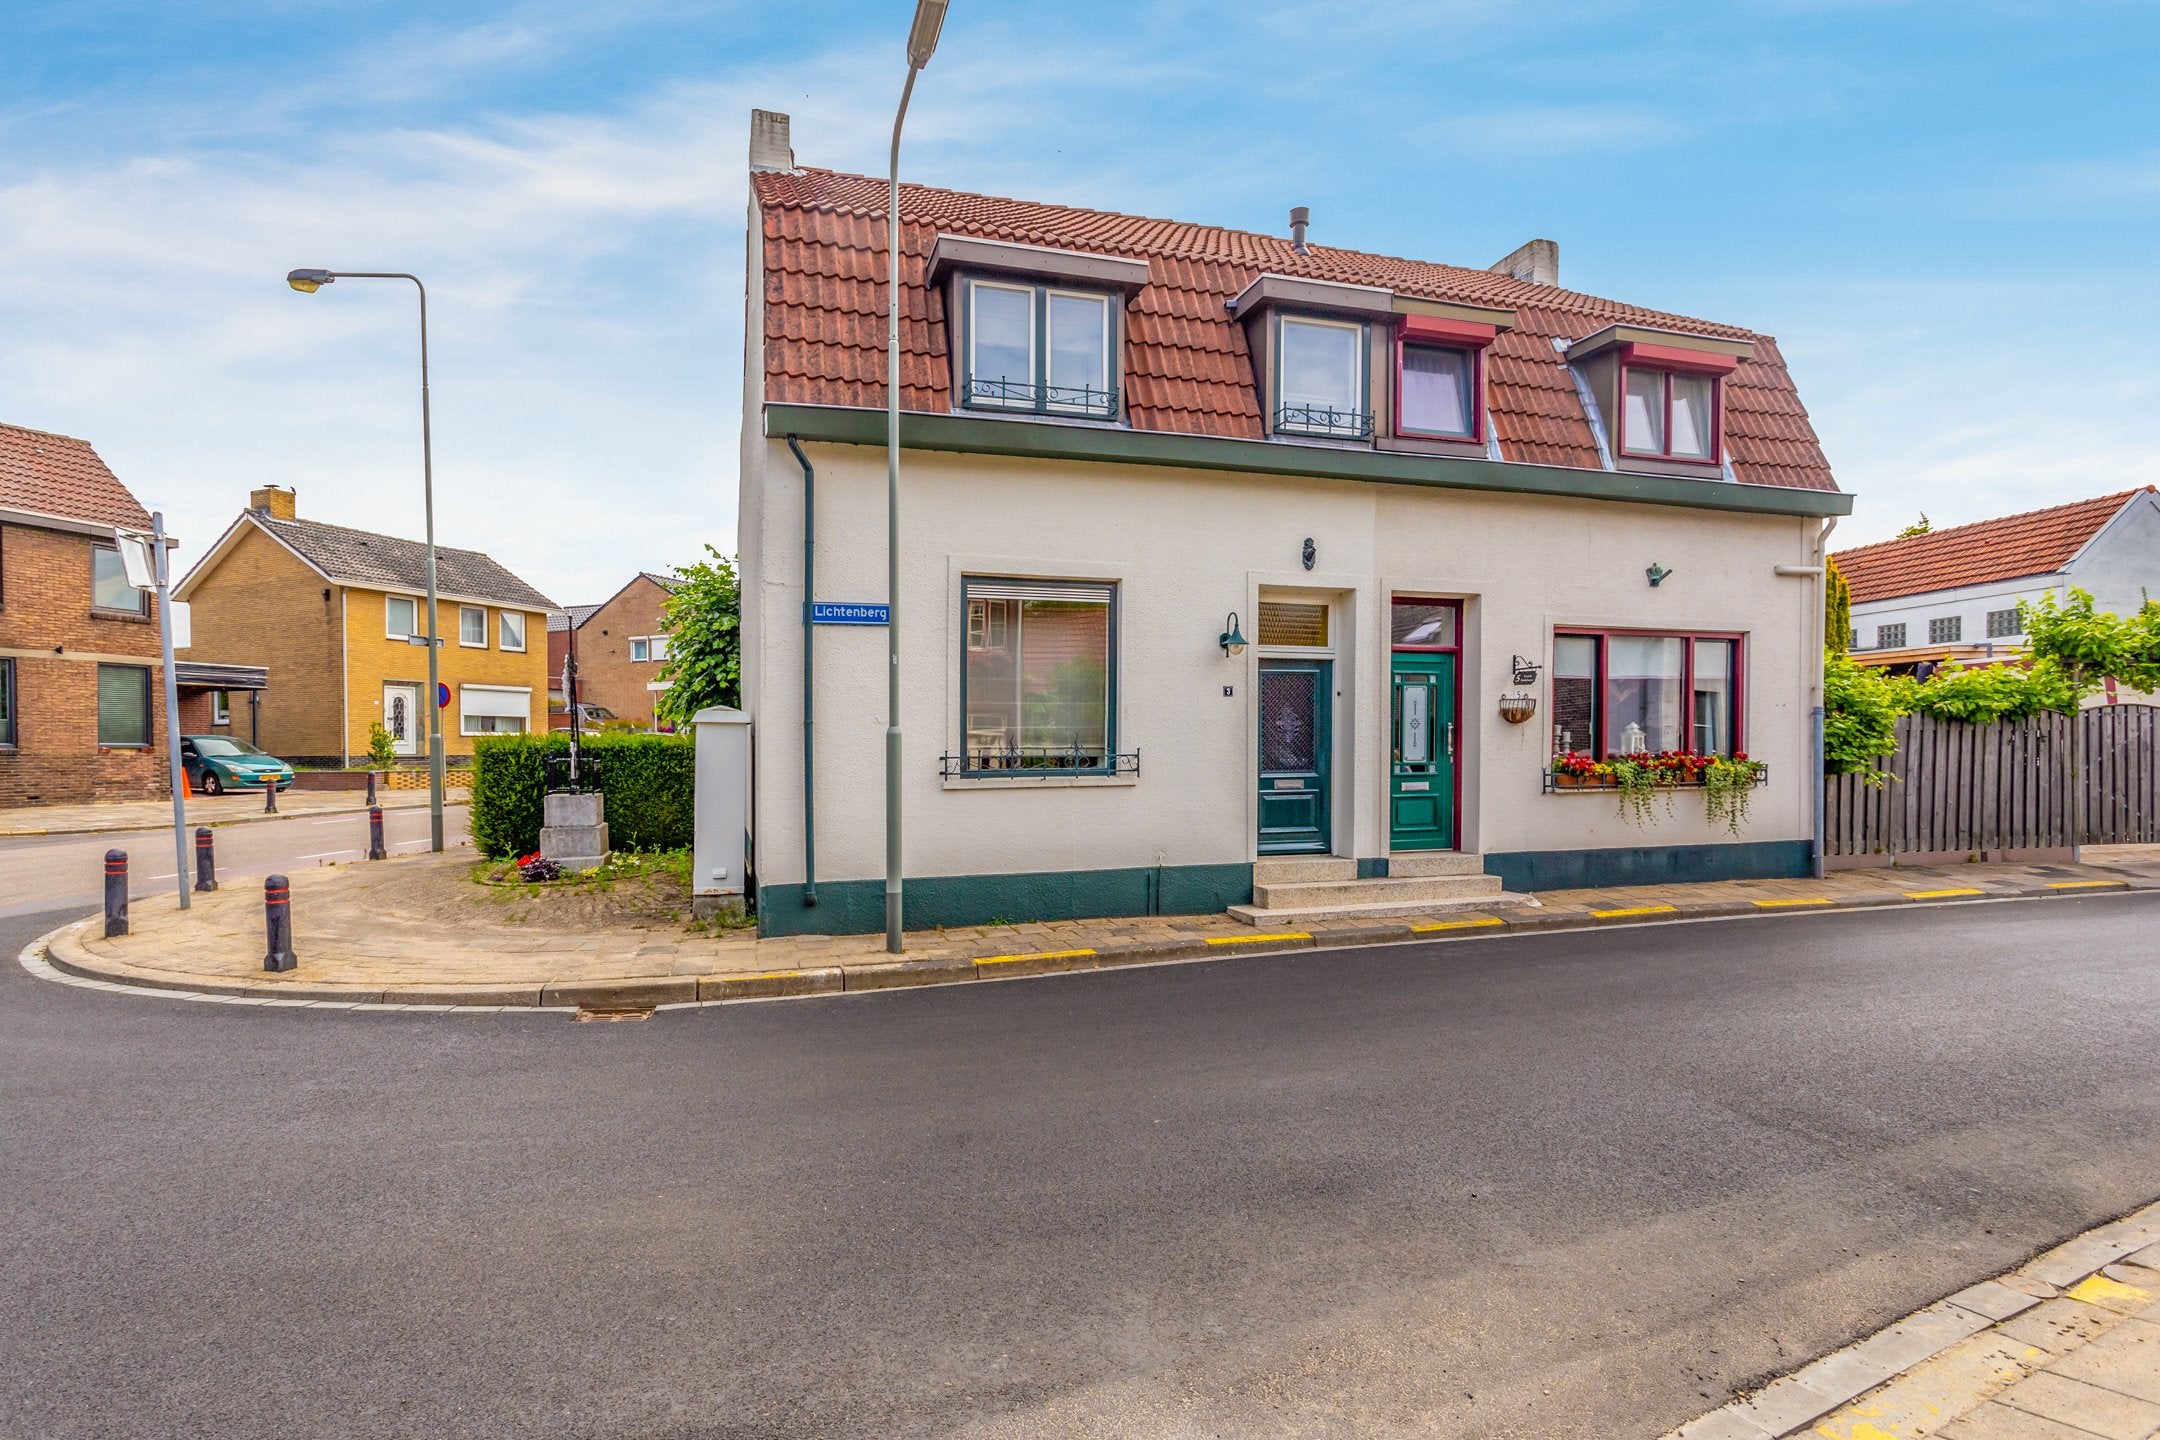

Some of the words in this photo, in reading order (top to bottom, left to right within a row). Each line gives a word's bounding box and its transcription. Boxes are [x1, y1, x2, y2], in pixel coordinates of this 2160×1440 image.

[815, 605, 887, 621] Lichtenberg
[1515, 674, 1521, 683] 5
[1226, 687, 1231, 696] 3
